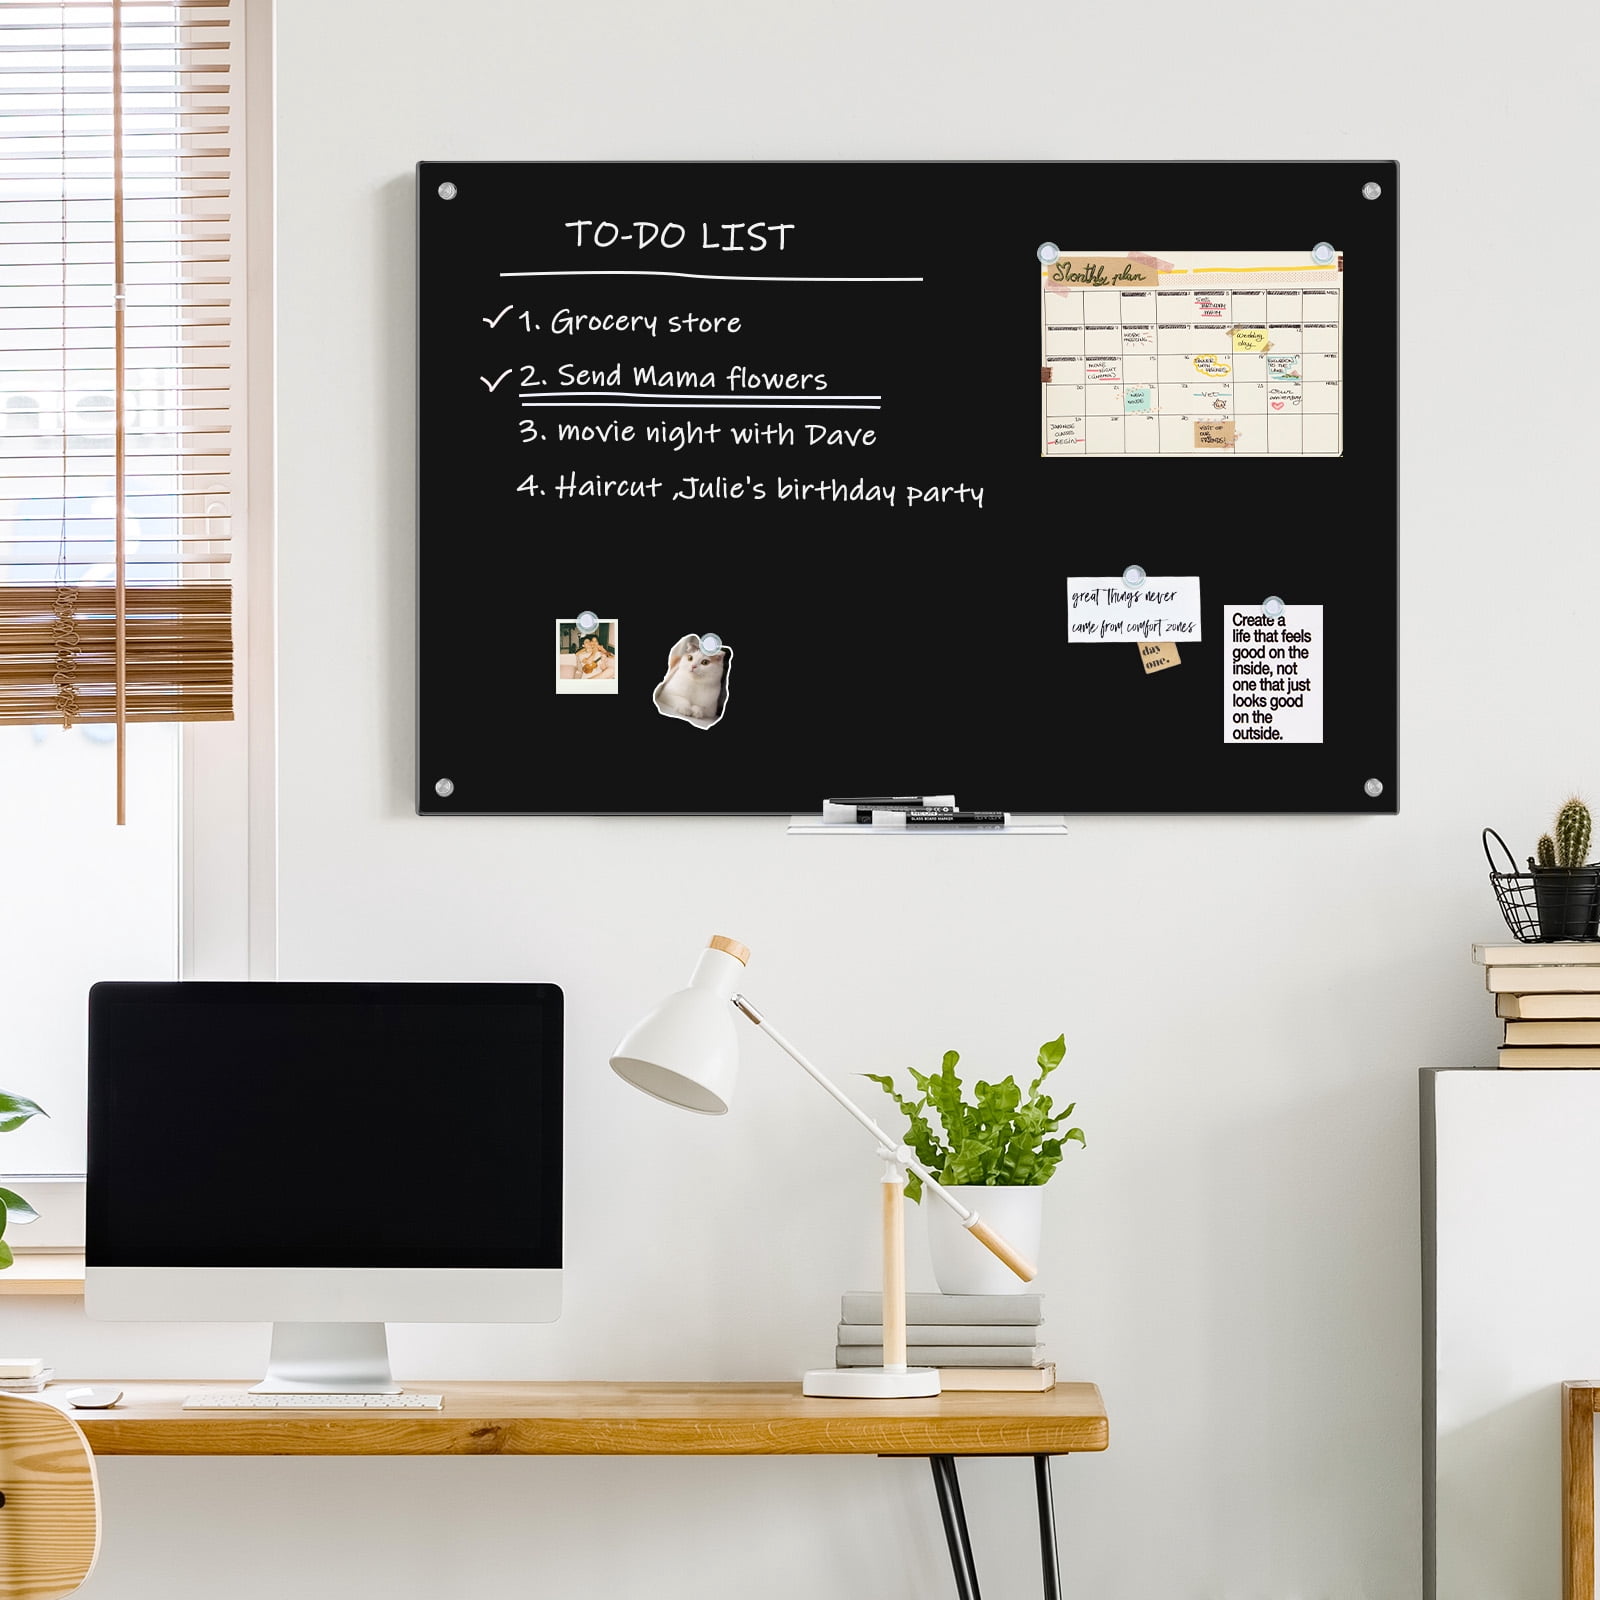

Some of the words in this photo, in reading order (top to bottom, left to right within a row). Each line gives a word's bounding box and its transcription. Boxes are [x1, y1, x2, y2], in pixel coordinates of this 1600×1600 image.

[565, 220, 685, 249] TO-DO
[703, 222, 795, 251] LIST
[1111, 264, 1146, 285] plan
[519, 311, 540, 332] 1.
[552, 309, 657, 337] Grocery
[669, 313, 741, 332] store
[520, 366, 547, 386] 2.
[559, 363, 620, 386] Send
[634, 366, 715, 387] Mama
[727, 366, 827, 391] flowers
[519, 420, 546, 442] 3.
[559, 421, 635, 442] movie
[647, 421, 721, 451] night
[731, 423, 793, 445] with
[805, 425, 876, 446] Dave
[517, 475, 545, 496] 4.
[555, 471, 662, 499] Haircut
[778, 477, 895, 506] birthday
[907, 483, 983, 508] party
[1072, 588, 1100, 608] great
[1101, 588, 1142, 608] things
[1145, 591, 1177, 602] never
[1232, 612, 1275, 627] Create
[1278, 616, 1286, 627] a
[1072, 623, 1098, 633] came
[1100, 619, 1124, 638] from
[1127, 619, 1168, 638] comfort
[1166, 622, 1196, 633] zones
[1232, 629, 1251, 642] life
[1253, 630, 1278, 642] that
[1281, 629, 1312, 642] feels
[1142, 645, 1161, 657] day
[1232, 646, 1266, 661] good
[1269, 649, 1285, 659] on
[1288, 646, 1309, 659] the
[1146, 658, 1170, 670] one.
[1232, 662, 1274, 677] inside,
[1276, 664, 1297, 675] not
[1232, 680, 1257, 691] one
[1260, 679, 1285, 691] that
[1286, 678, 1311, 694] just
[1232, 694, 1267, 707] looks
[1270, 694, 1303, 710] good
[1232, 713, 1249, 724] on
[1252, 710, 1273, 724] the
[1232, 726, 1283, 740] outside.
